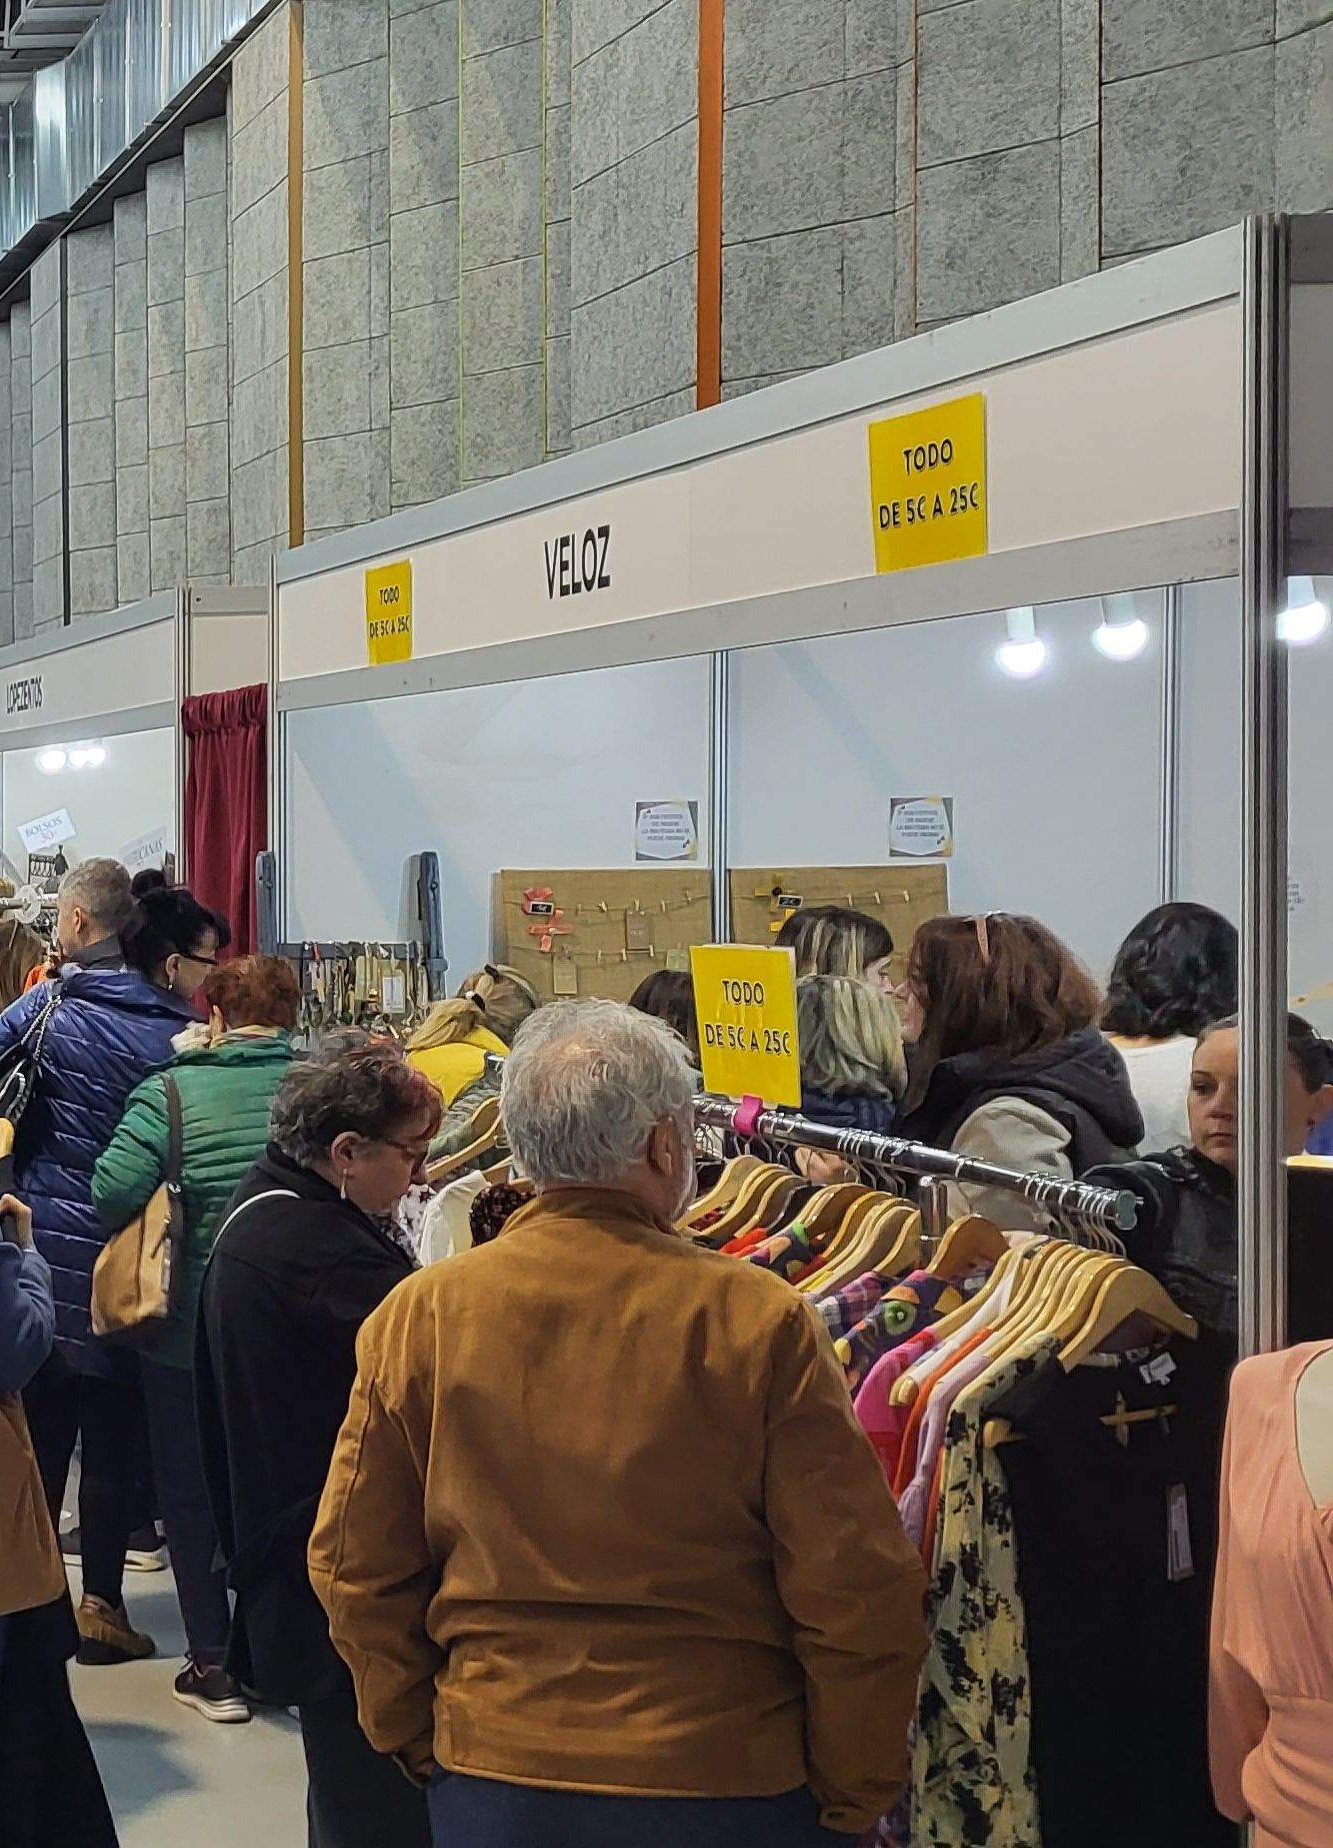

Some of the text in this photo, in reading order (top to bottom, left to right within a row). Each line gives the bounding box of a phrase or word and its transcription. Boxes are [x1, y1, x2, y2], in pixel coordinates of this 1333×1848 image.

[903, 438, 954, 475] TODO
[879, 501, 901, 530] DE
[931, 493, 945, 521] A
[544, 523, 611, 600] VELOZ
[379, 585, 400, 605] TODO
[369, 621, 379, 639] DE
[24, 815, 64, 838] BOLSOS
[722, 980, 765, 1006] TODO
[704, 1023, 724, 1047] DE
[750, 1028, 760, 1053] A
